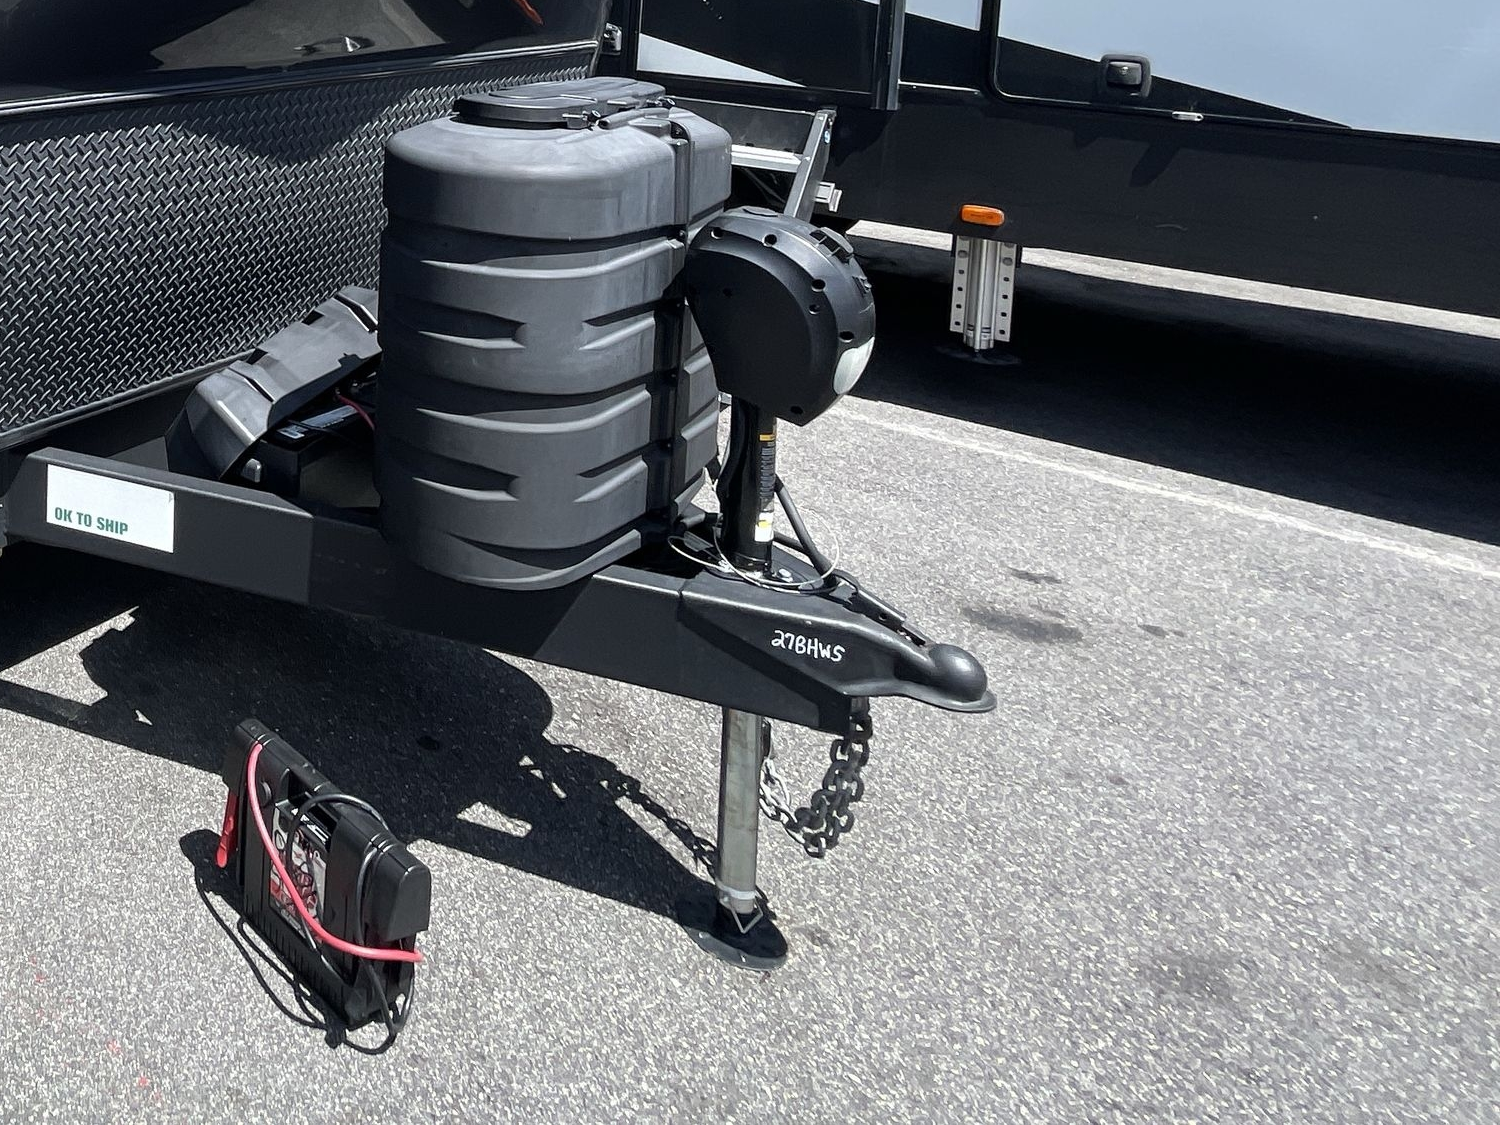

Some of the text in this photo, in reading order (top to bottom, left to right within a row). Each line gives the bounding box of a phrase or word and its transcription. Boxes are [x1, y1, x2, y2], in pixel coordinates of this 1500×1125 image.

[54, 507, 129, 535] OK TO SHIP
[771, 629, 846, 662] 27BHWS
